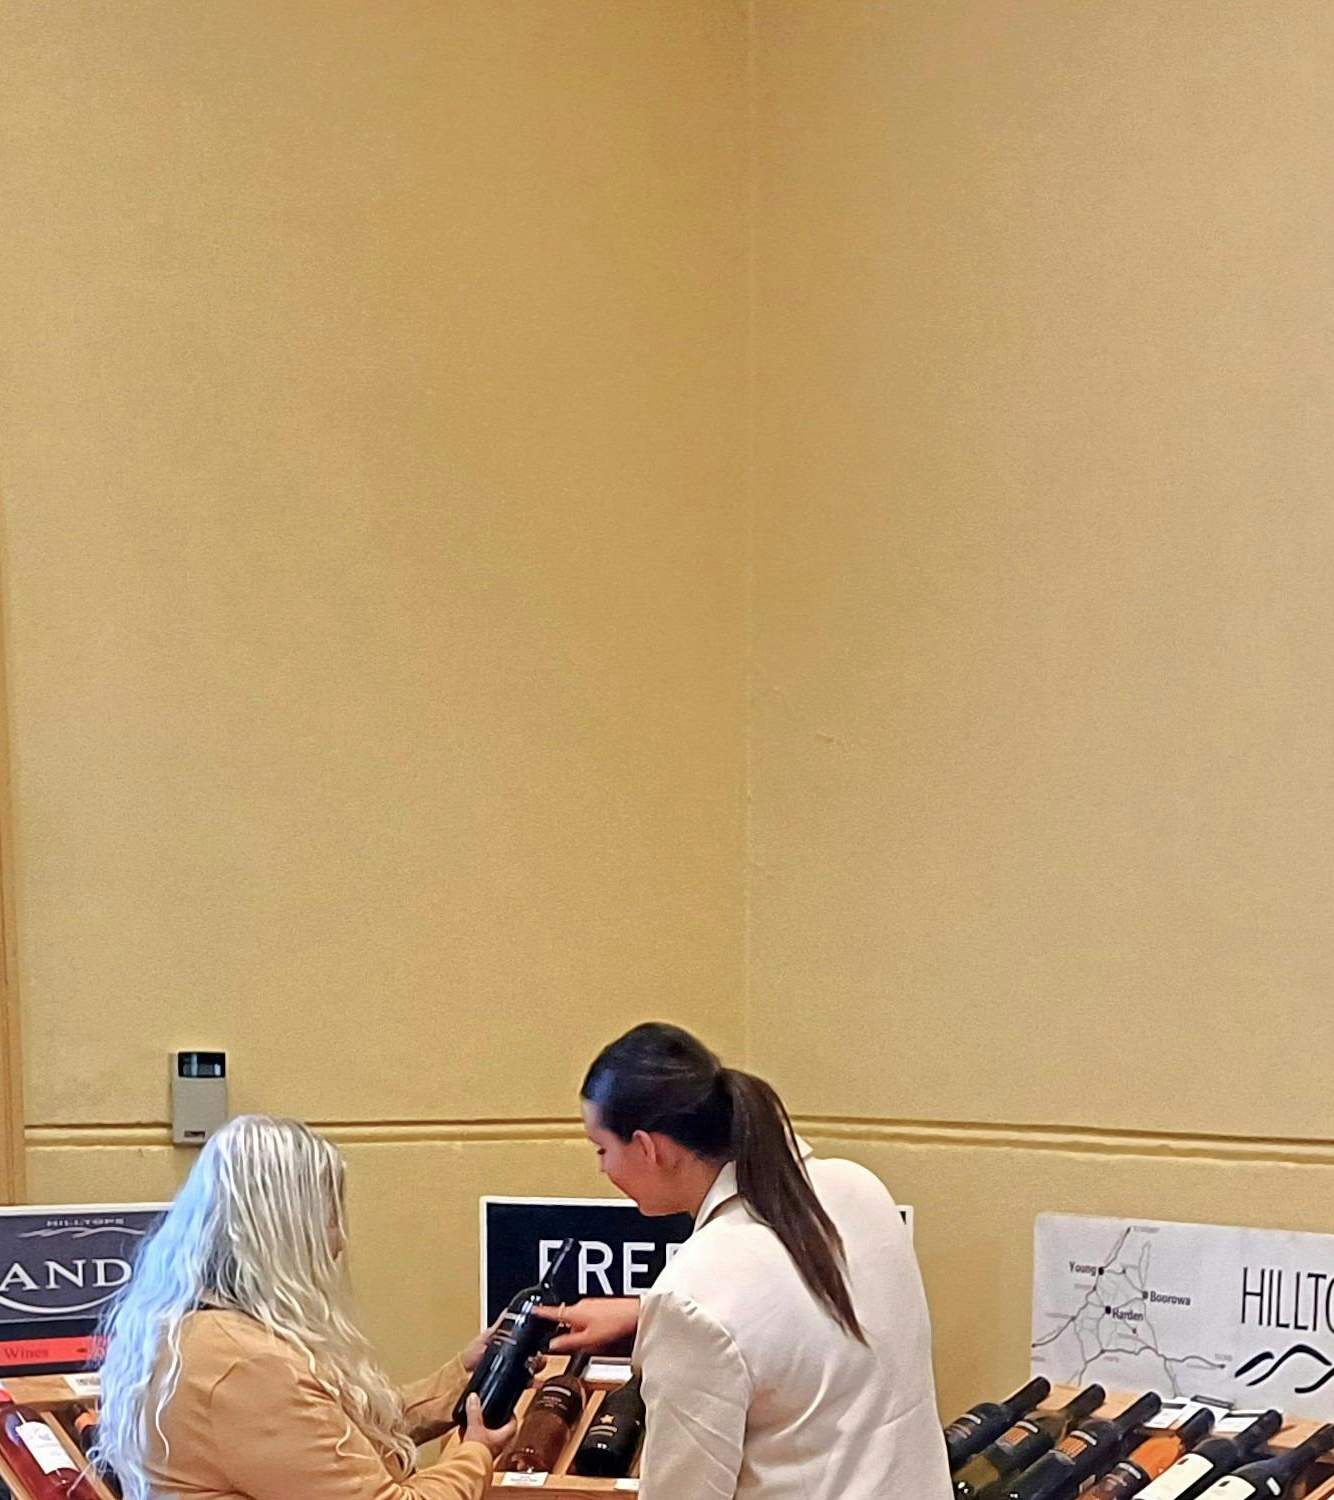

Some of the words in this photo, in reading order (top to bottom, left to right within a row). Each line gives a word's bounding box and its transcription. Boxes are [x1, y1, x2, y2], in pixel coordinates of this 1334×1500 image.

[1068, 1260, 1097, 1277] Young
[1150, 1290, 1191, 1306] Boorowa
[1112, 1306, 1144, 1321] Harden
[4, 1346, 50, 1361] Wines
